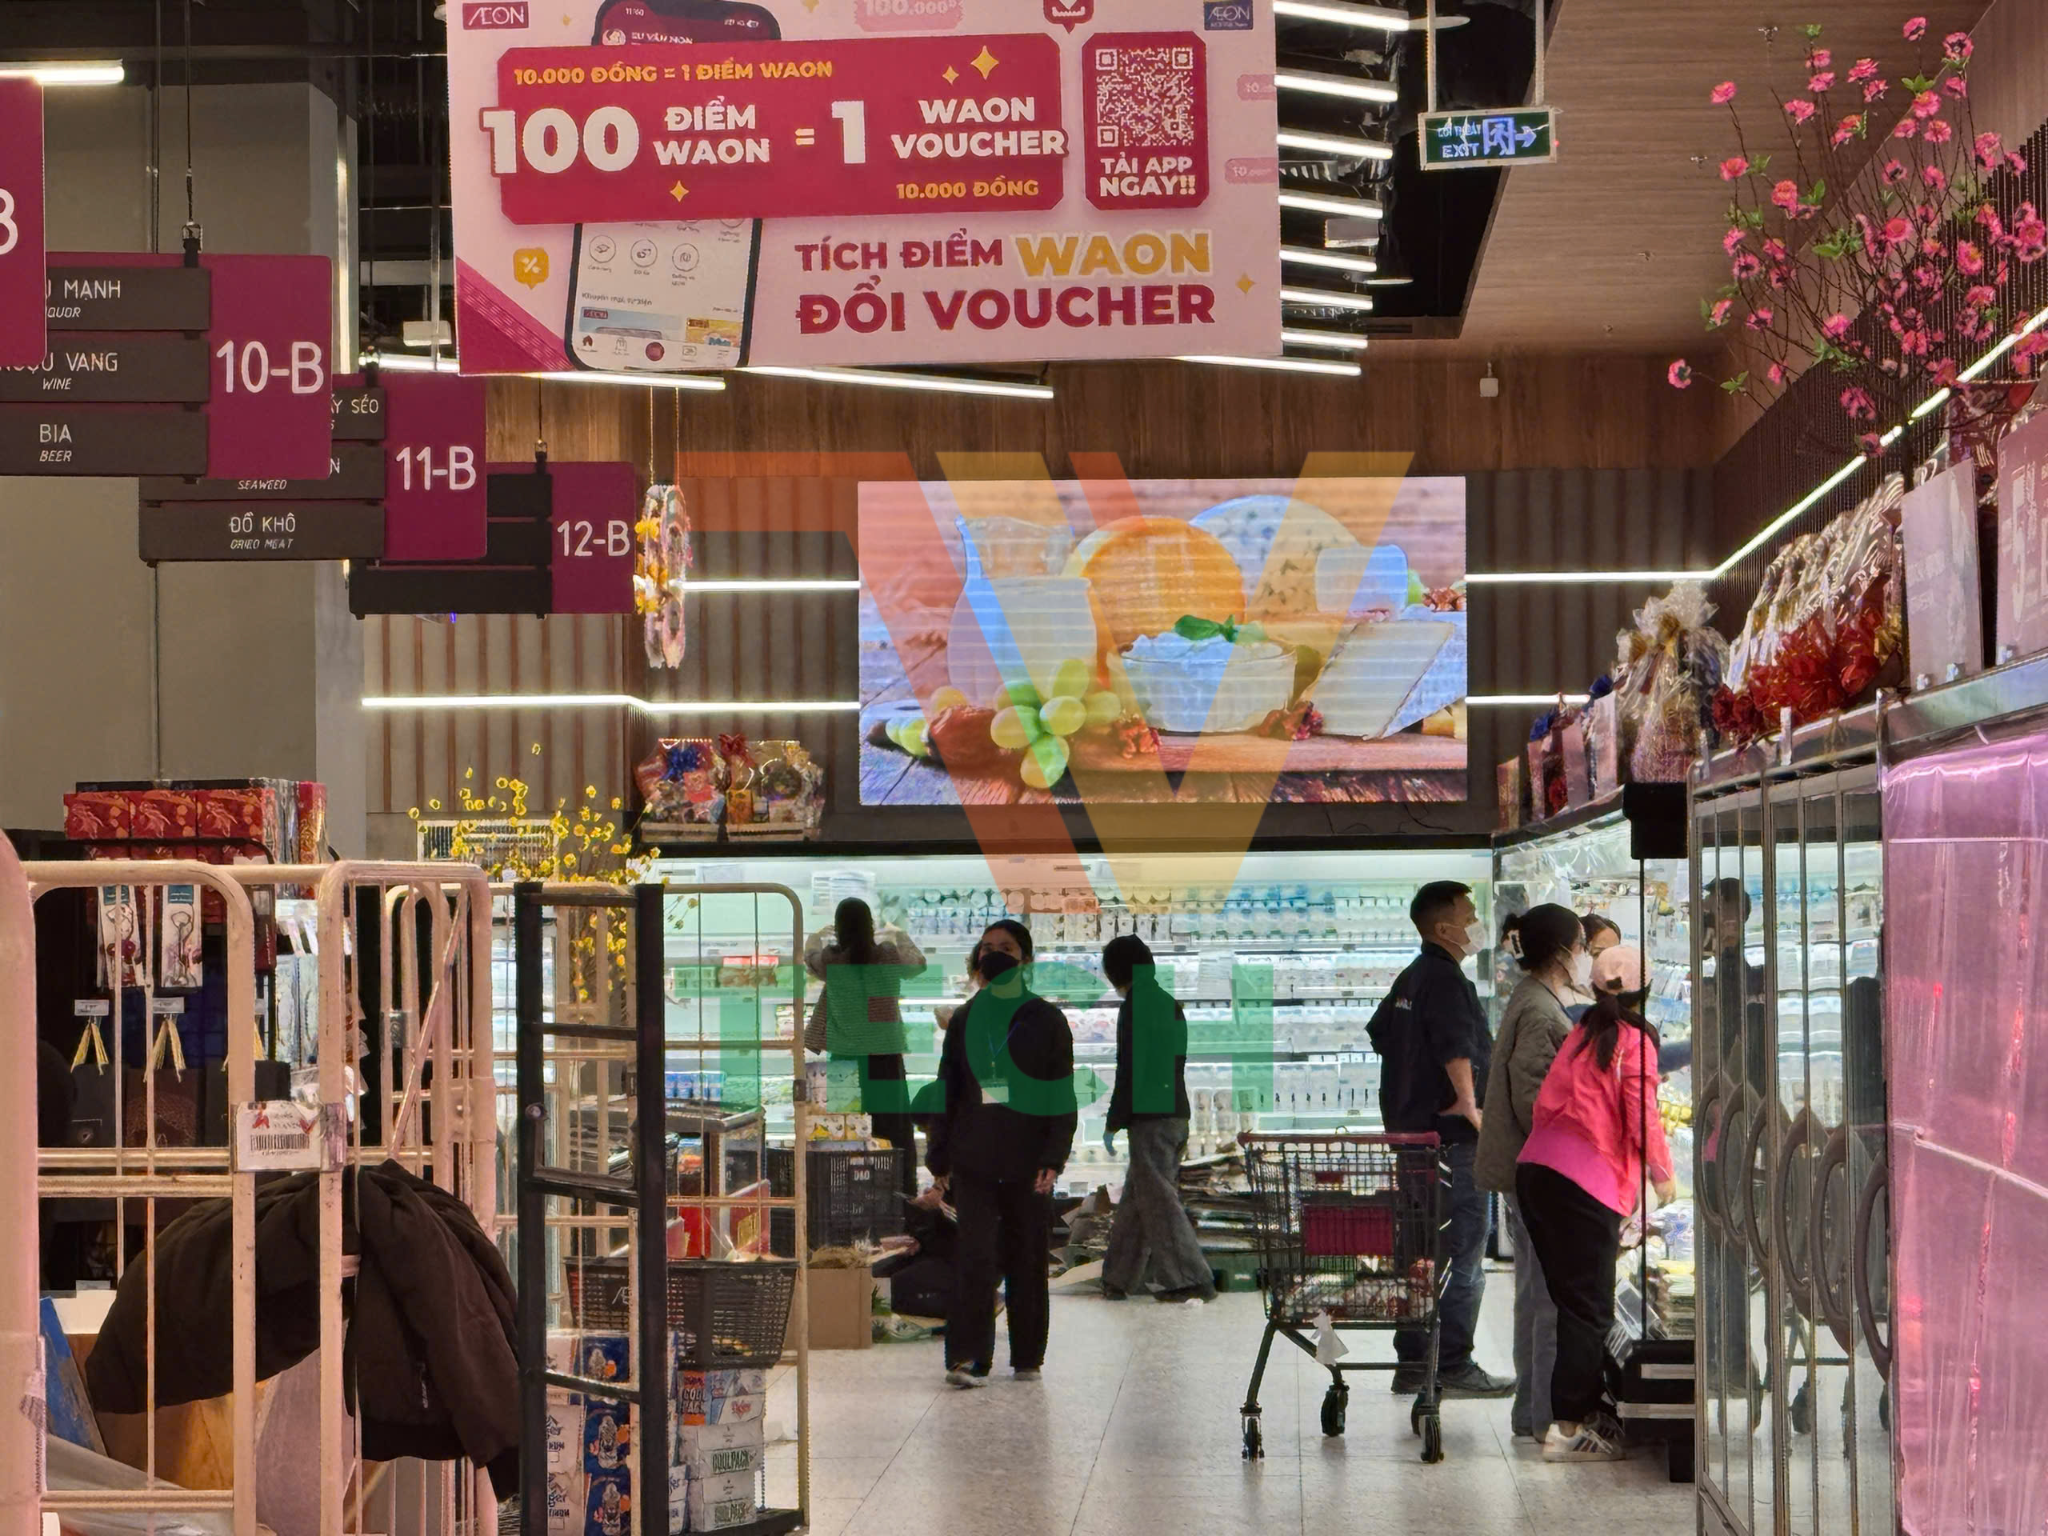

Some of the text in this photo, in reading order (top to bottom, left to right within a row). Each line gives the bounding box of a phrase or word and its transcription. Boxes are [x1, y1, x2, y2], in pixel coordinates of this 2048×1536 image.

[514, 67, 585, 85] 10.000
[682, 64, 691, 81] 1
[696, 57, 753, 81] ĐIỂM
[760, 61, 833, 79] WAON
[664, 95, 756, 131] ĐIỂM
[918, 97, 1035, 124] WAON
[482, 105, 640, 174] 100
[795, 127, 816, 146] =
[832, 99, 867, 165] 1
[891, 130, 1068, 159] VOUCHER
[653, 138, 770, 166] WAON
[1442, 142, 1480, 158] EXIT
[1100, 152, 1193, 175] TẢI APP
[896, 183, 966, 200] 10.000
[1100, 175, 1196, 197] NGAY!!
[795, 228, 1212, 278] TÍCH ĐIỂM WAON
[64, 279, 121, 301] MẠNH
[795, 274, 1216, 335] ĐỔI VOUCHER
[66, 352, 118, 372] VANG
[216, 340, 325, 395] 10-B
[42, 378, 72, 390] WINE
[39, 424, 72, 443] BIA
[39, 450, 72, 462] BEER
[395, 446, 477, 491] 11-B
[238, 480, 287, 490] SEAWEED
[229, 511, 296, 533] ĐỒ KHÔ
[557, 520, 631, 557] 12-B
